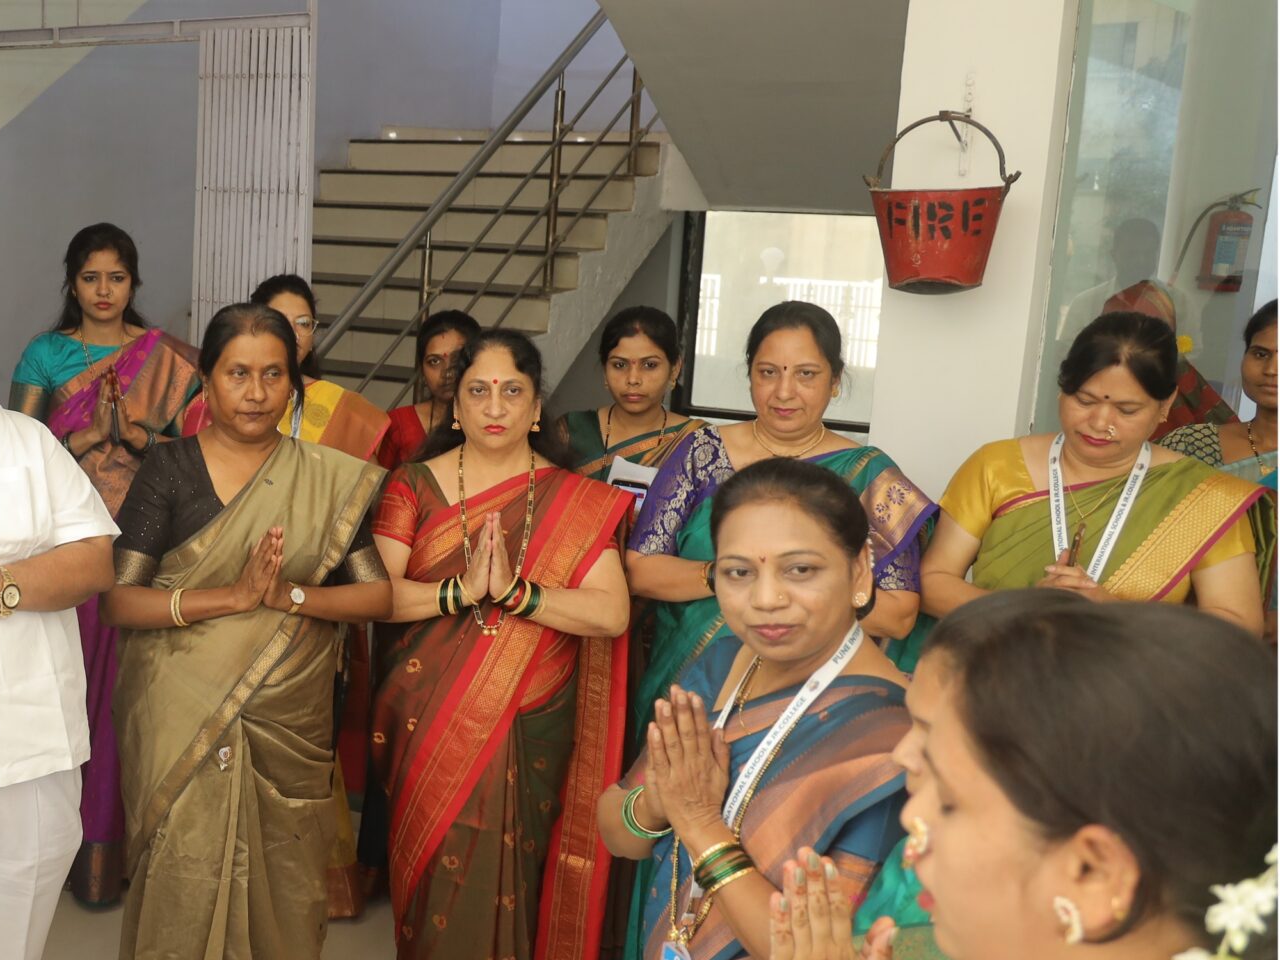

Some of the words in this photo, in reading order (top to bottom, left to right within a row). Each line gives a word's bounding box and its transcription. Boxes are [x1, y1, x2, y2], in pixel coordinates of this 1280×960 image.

[887, 198, 986, 240] FIRE
[833, 647, 851, 665] PUNE
[744, 748, 767, 779] SCHOOL
